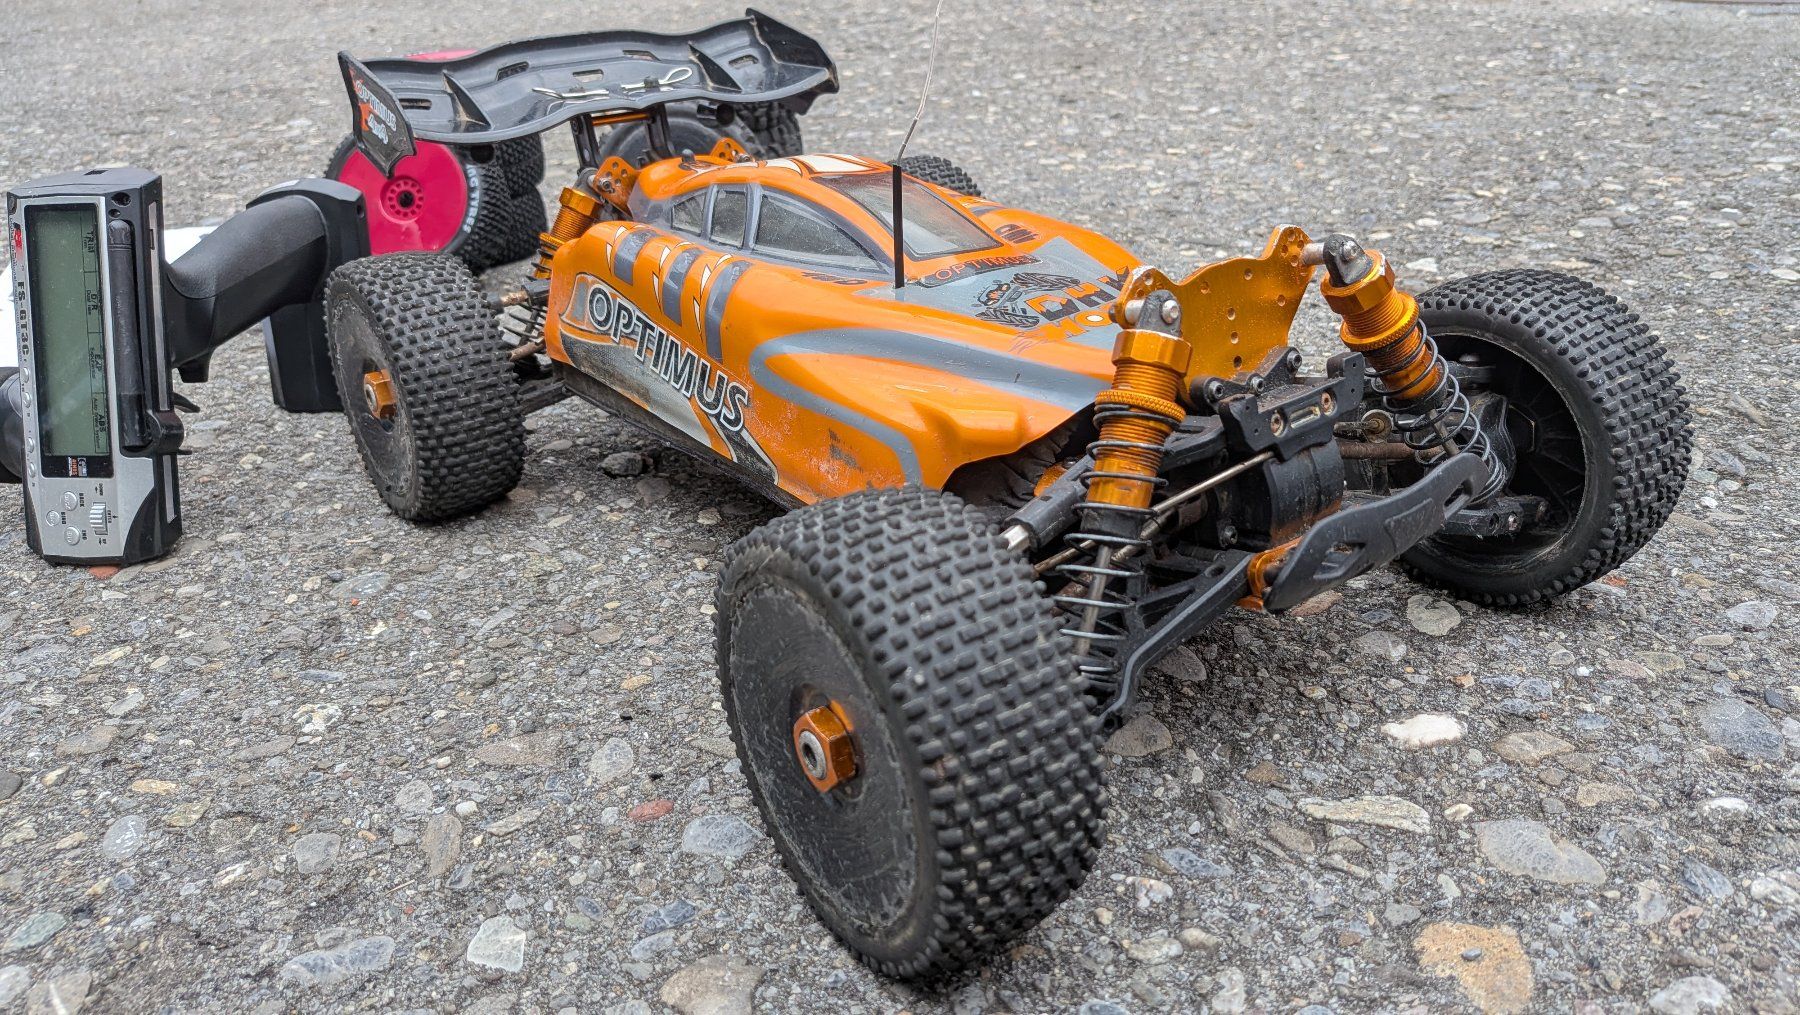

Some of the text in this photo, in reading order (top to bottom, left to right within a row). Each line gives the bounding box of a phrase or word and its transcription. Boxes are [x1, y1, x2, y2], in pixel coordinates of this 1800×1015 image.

[463, 190, 480, 234] TYRES
[18, 281, 29, 356] FS-GT3C
[587, 283, 749, 431] OPTIMUS
[99, 414, 107, 432] ABS
